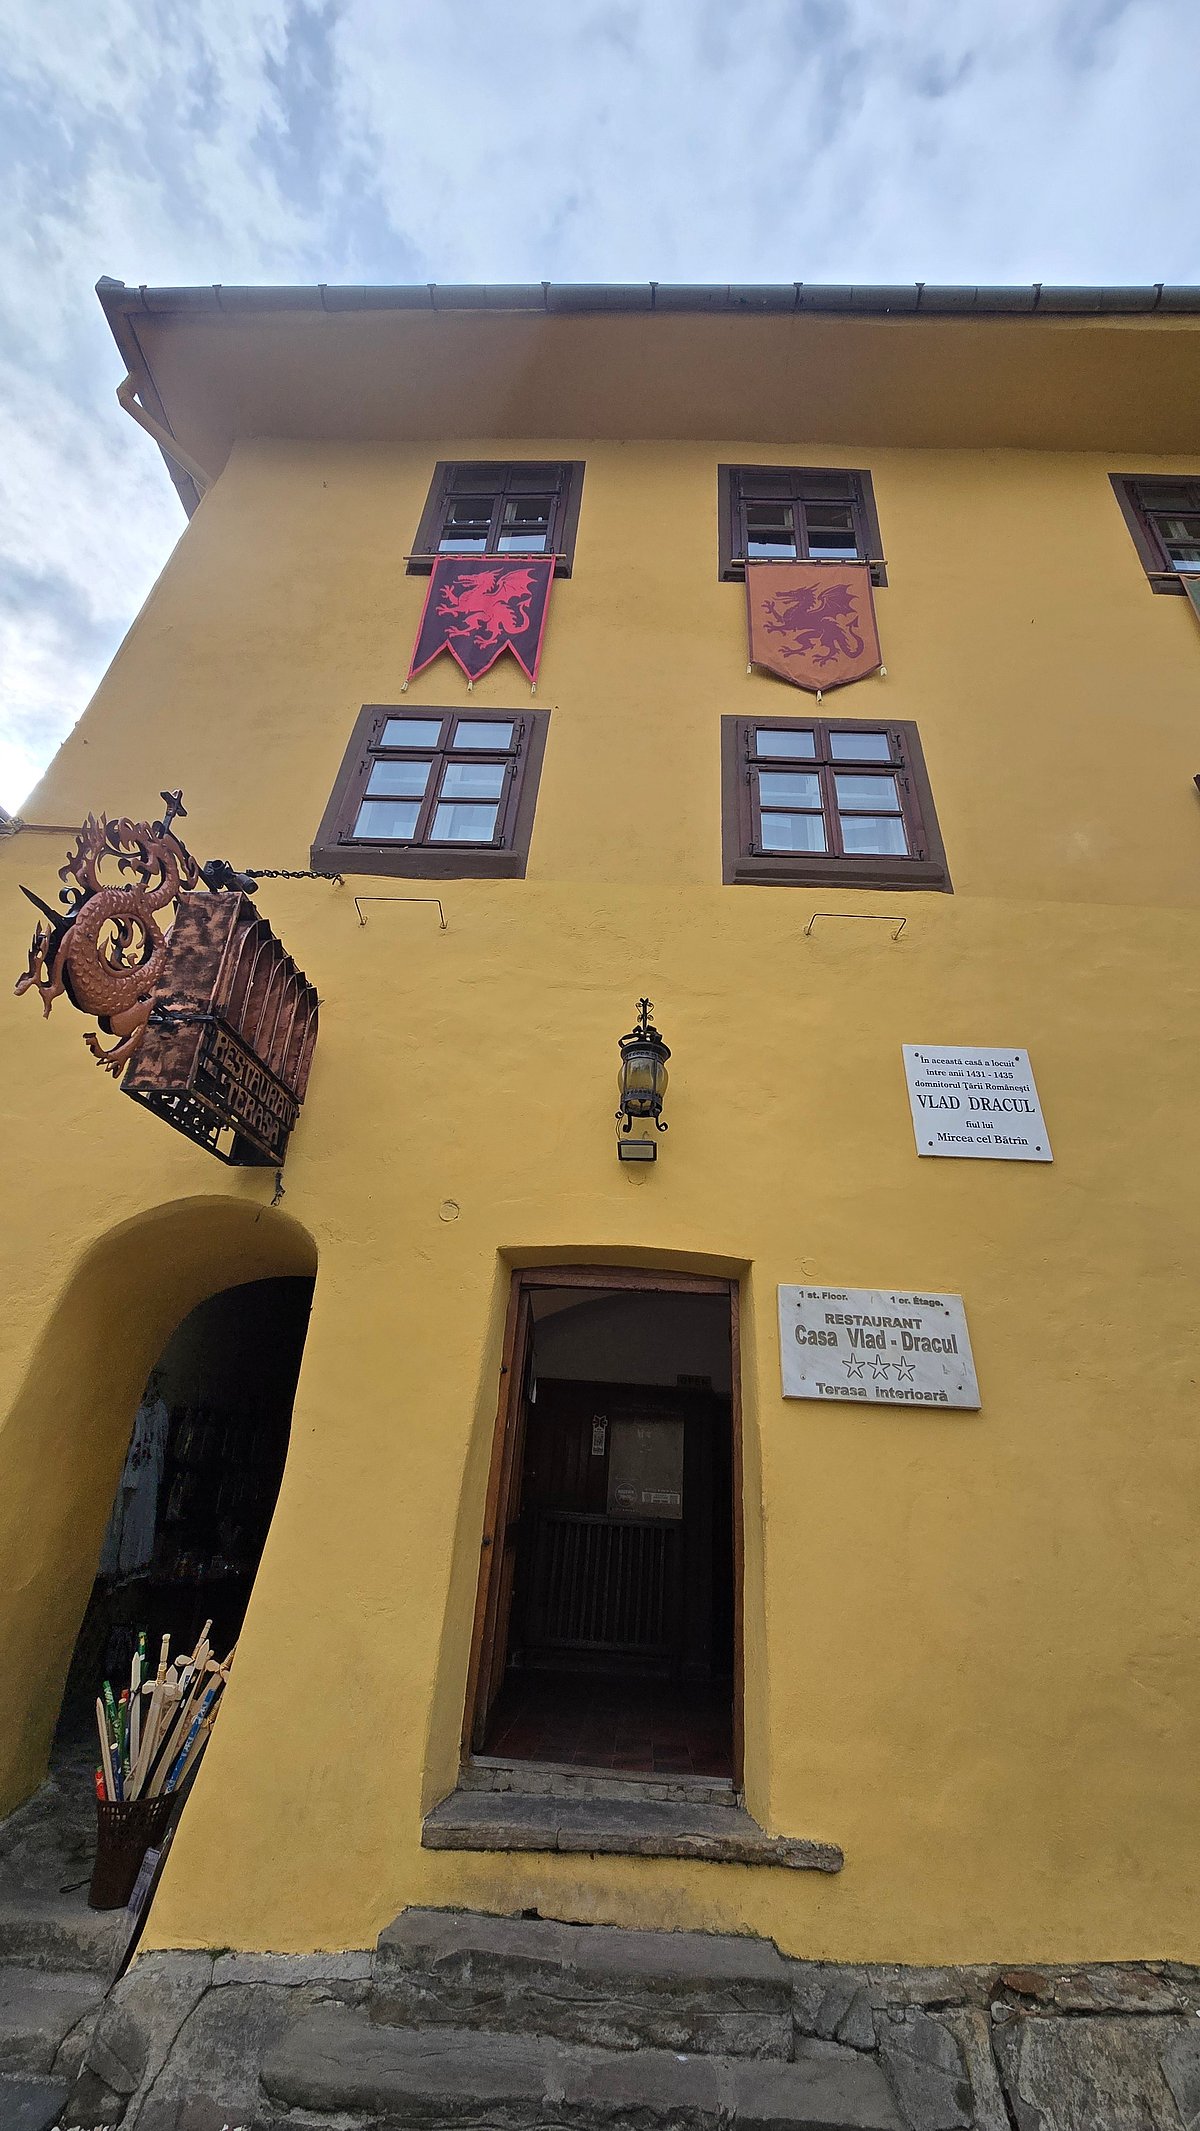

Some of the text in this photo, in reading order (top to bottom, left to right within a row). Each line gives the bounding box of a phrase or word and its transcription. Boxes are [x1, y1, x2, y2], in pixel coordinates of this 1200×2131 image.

[991, 1059, 1015, 1068] locuit
[966, 1070, 986, 1078] 1431
[993, 1071, 1014, 1079] 1435
[914, 1079, 961, 1089] domnitorul
[916, 1094, 1036, 1113] VLAD DRACUL
[225, 1077, 281, 1146] TERASA
[965, 1120, 994, 1129] fiul lui
[936, 1132, 974, 1143] Mircea
[976, 1134, 993, 1144] cel
[799, 1290, 849, 1301] 1 st. Floor.
[890, 1296, 896, 1304] 1
[824, 1313, 923, 1330] RESTAURANT
[795, 1324, 838, 1347] Casa
[847, 1327, 887, 1350] Vlad
[901, 1331, 959, 1355] Dracul
[816, 1382, 949, 1402] Terasa interioară
